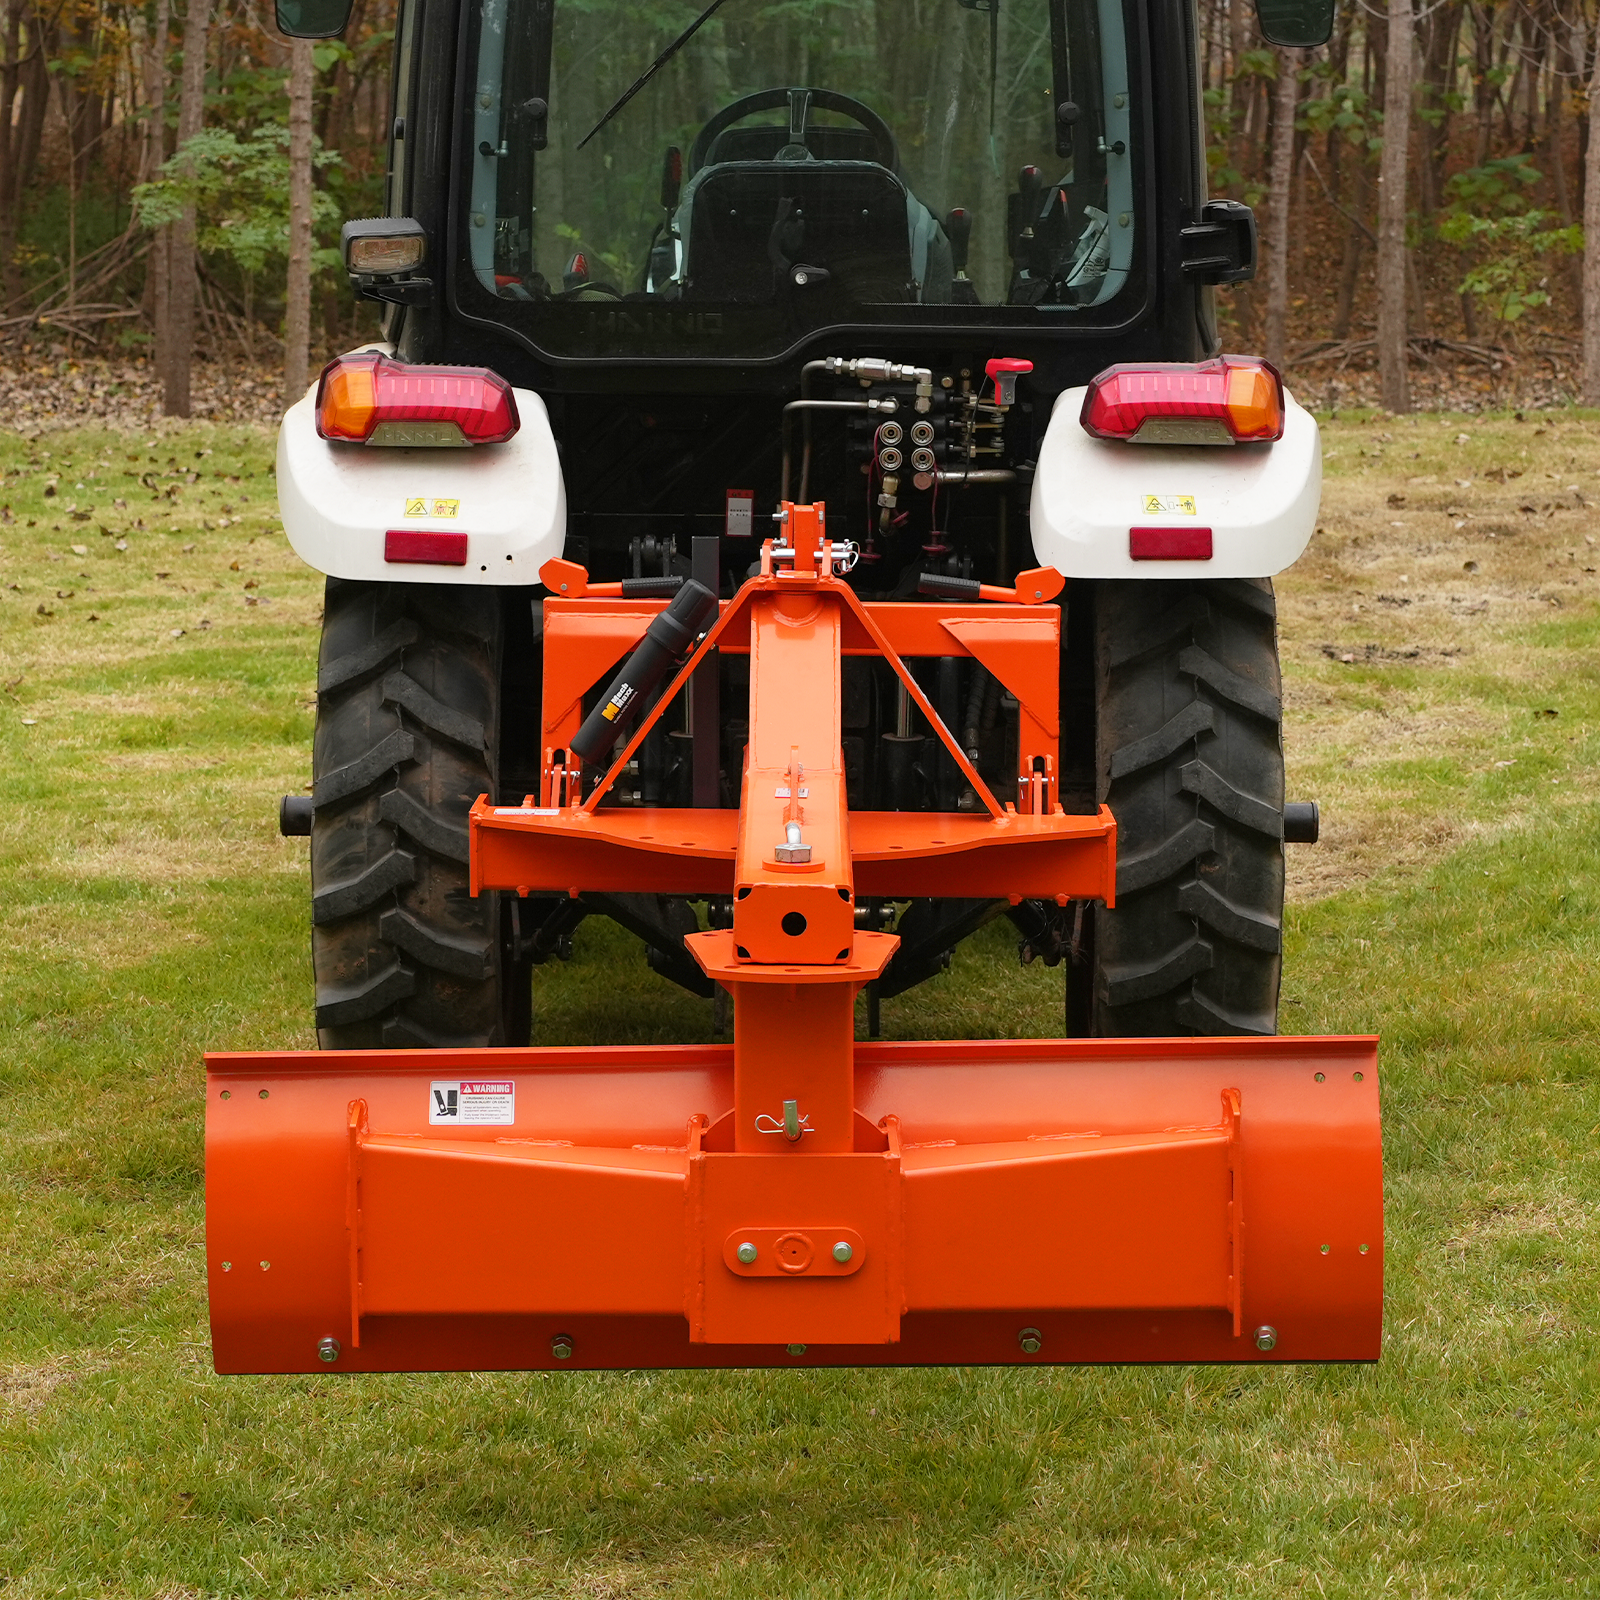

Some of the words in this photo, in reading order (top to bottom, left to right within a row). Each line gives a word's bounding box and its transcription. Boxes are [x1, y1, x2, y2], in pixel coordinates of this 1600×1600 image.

[610, 682, 629, 705] Mech
[615, 686, 635, 709] Maxx
[472, 1084, 510, 1093] WARNING
